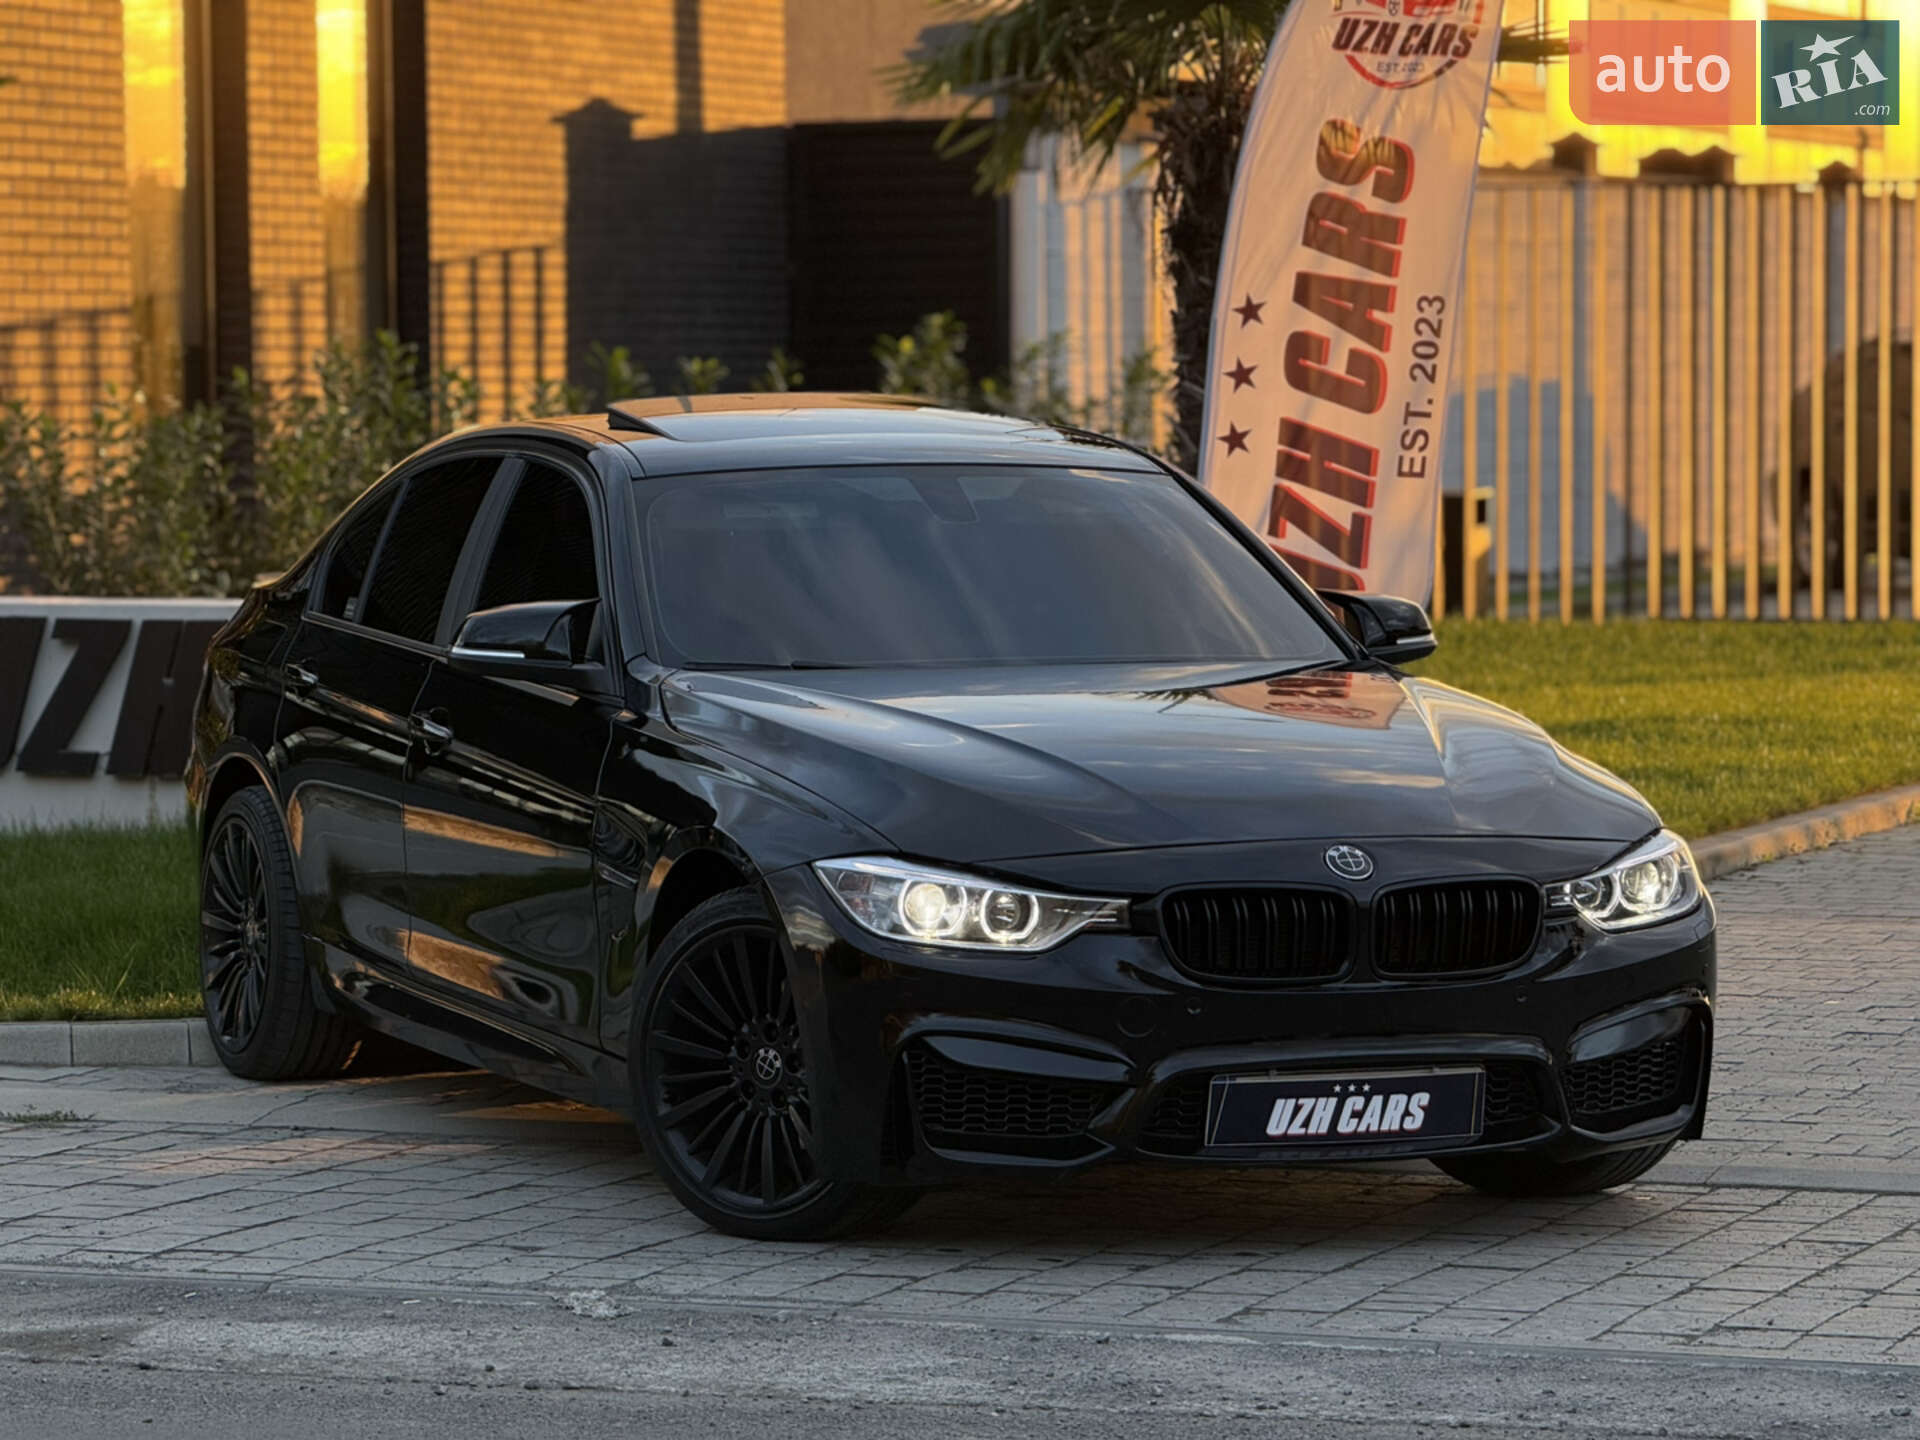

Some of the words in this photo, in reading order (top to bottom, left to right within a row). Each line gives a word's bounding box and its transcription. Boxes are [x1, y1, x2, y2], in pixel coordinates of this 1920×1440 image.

[1332, 17, 1400, 55] UZH
[1398, 22, 1479, 59] CARS
[1283, 118, 1415, 415] CARS
[1409, 294, 1446, 384] 2023
[1397, 397, 1435, 479] EST.
[1266, 1096, 1338, 1137] UZH
[1336, 1091, 1431, 1134] CARS
